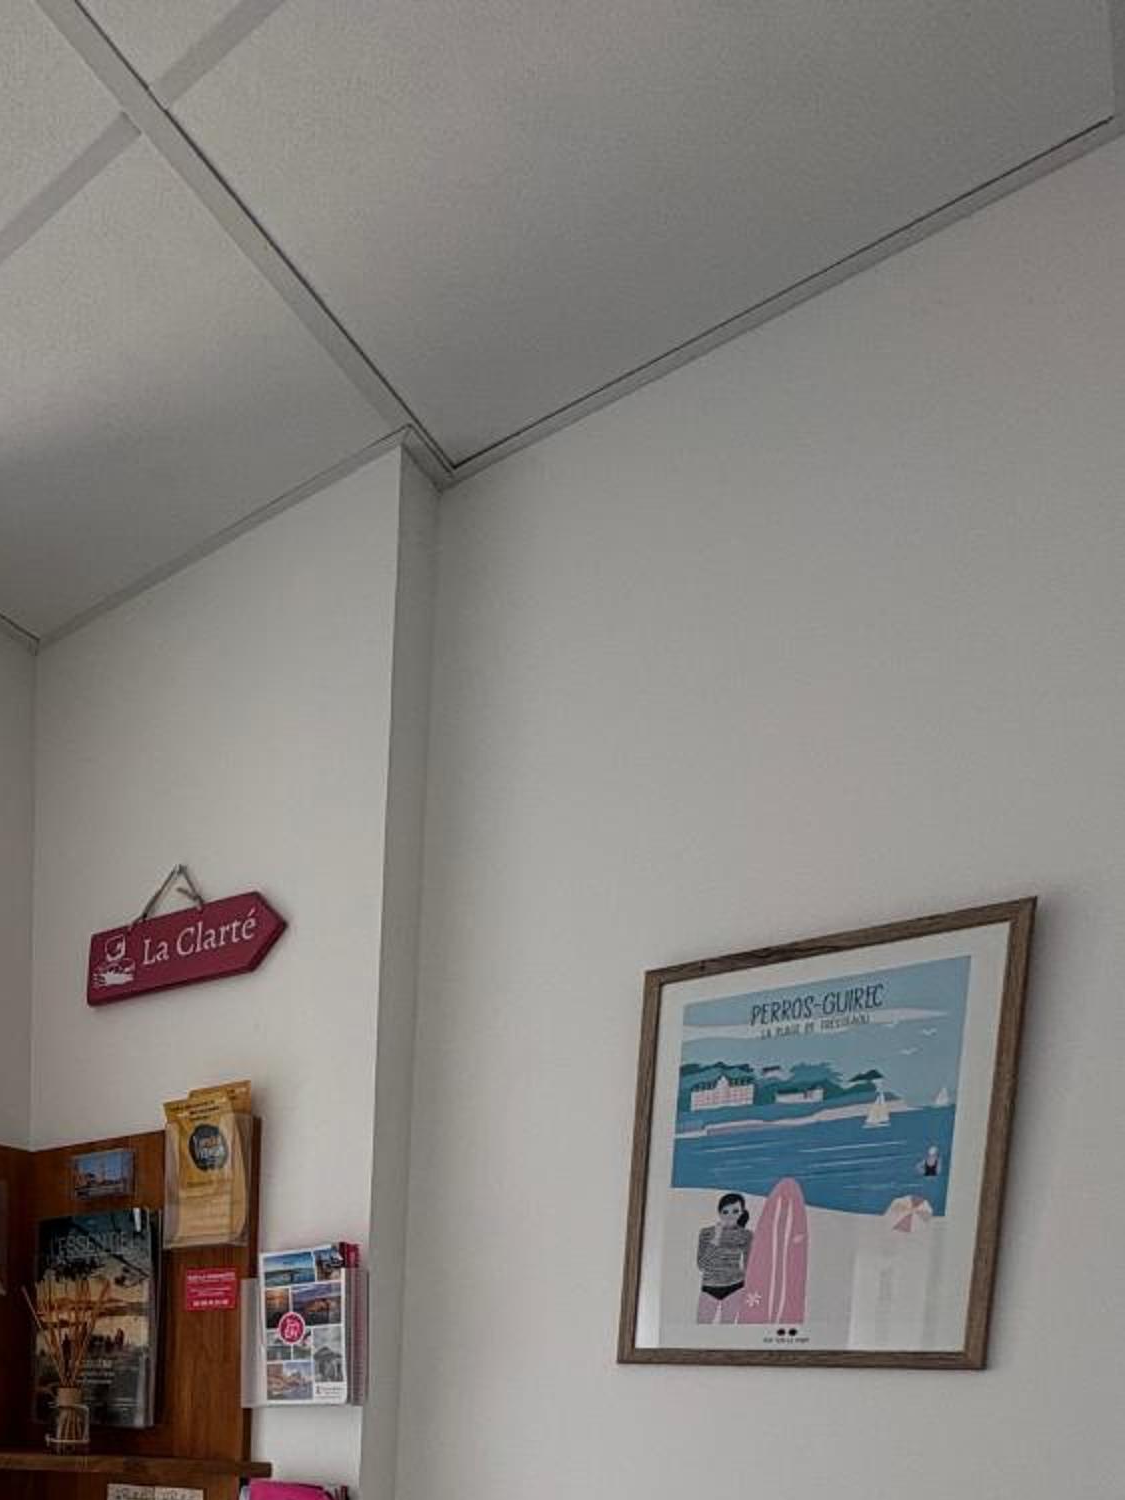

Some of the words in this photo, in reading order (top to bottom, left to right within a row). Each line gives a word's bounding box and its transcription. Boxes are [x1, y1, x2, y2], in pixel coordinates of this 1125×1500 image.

[143, 938, 170, 965] La
[176, 907, 257, 957] Clarté
[750, 984, 884, 1026] PERROS-GUIREC
